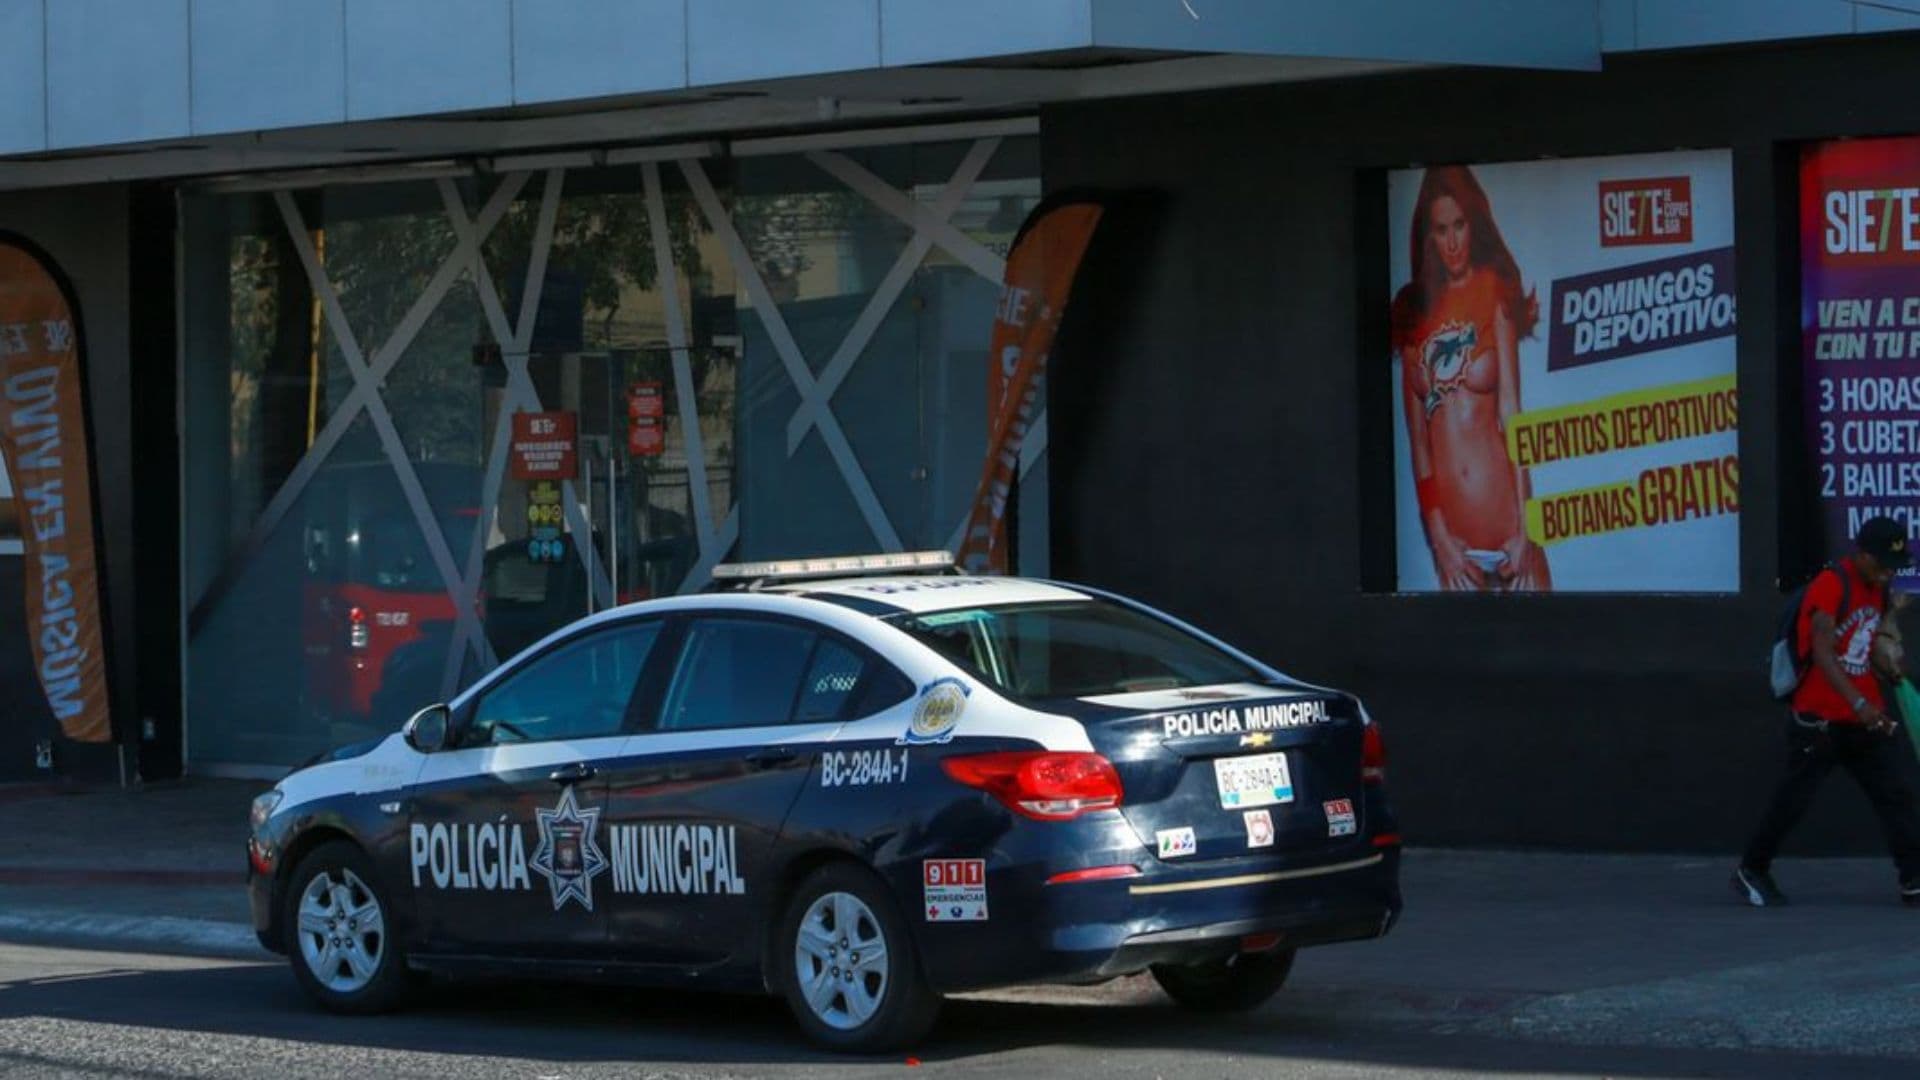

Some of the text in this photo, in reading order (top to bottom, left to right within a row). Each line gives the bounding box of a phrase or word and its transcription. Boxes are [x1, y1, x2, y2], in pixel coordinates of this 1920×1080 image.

[1562, 263, 1714, 325] DOMINGOS
[1818, 299, 1872, 328] VEN
[1876, 298, 1895, 326] A
[1815, 333, 1866, 360] CON
[1873, 332, 1904, 359] TU
[1819, 376, 1920, 412] 3 HORAS
[1515, 389, 1738, 466] EVENTOS DEPORTIVOS
[1820, 420, 1920, 455] 3 CUBET
[1541, 455, 1739, 540] BOTANAS GRATIS
[1821, 463, 1920, 497] 2 BAILES
[1164, 700, 1330, 738] POLICÍA MUNICIPAL
[821, 748, 909, 787] BC-284A-1
[410, 814, 745, 895] POLICÍA MUNICIPAL
[928, 864, 978, 884] 911
